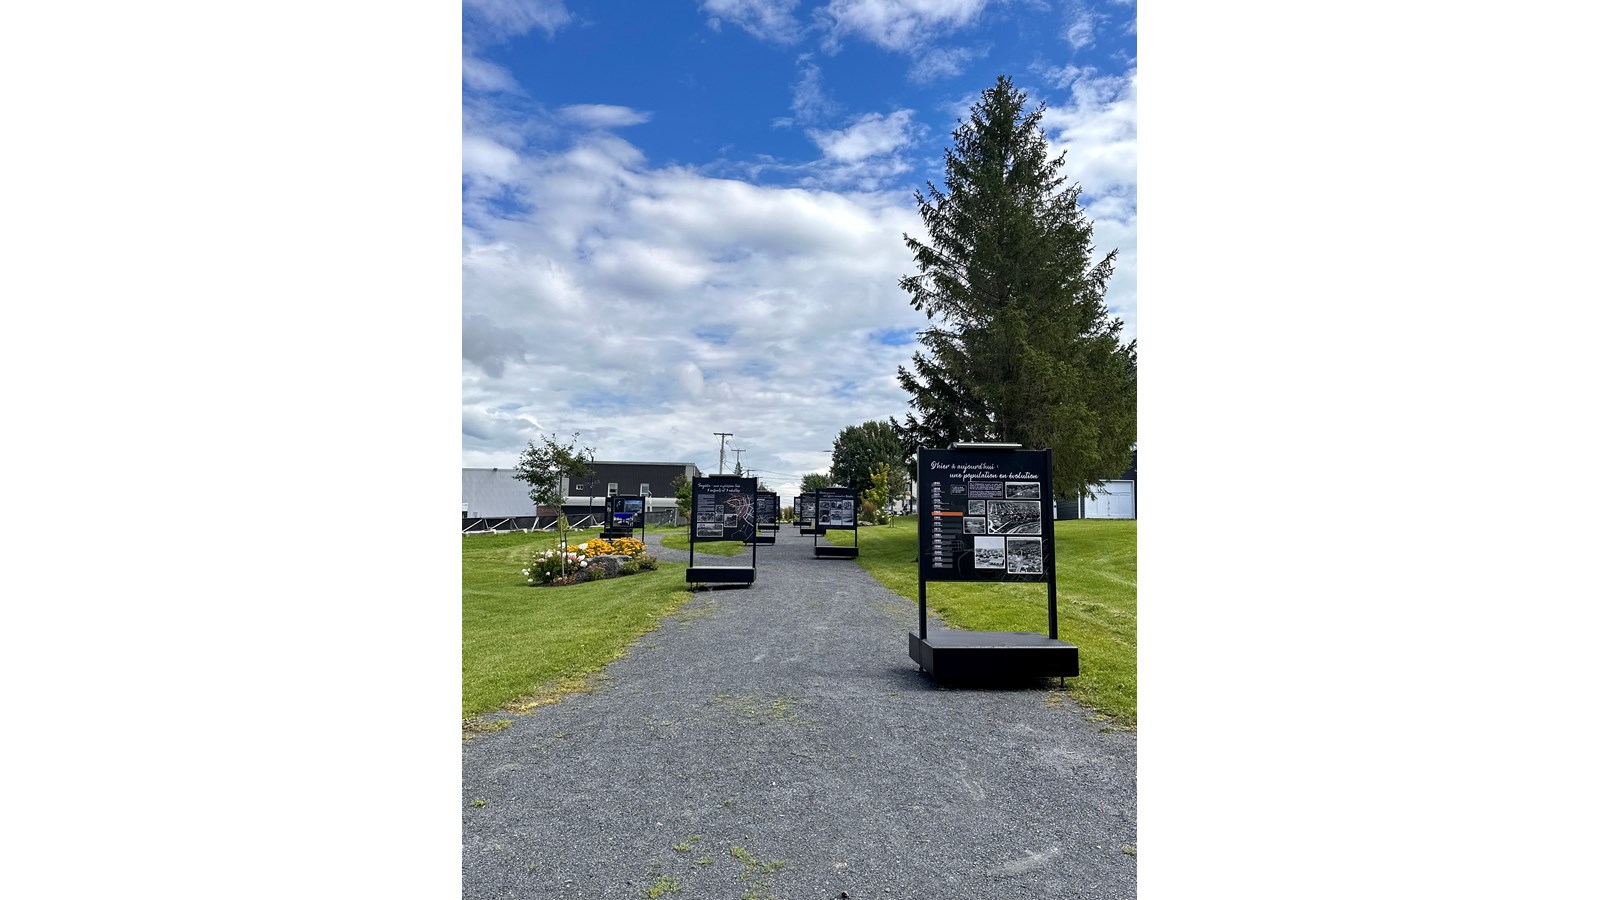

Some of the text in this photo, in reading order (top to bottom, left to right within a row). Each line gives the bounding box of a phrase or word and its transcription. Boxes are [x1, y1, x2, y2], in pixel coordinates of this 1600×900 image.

[957, 462, 994, 473] aujourd'hui
[962, 471, 998, 482] population
[1008, 471, 1039, 479] évolution
